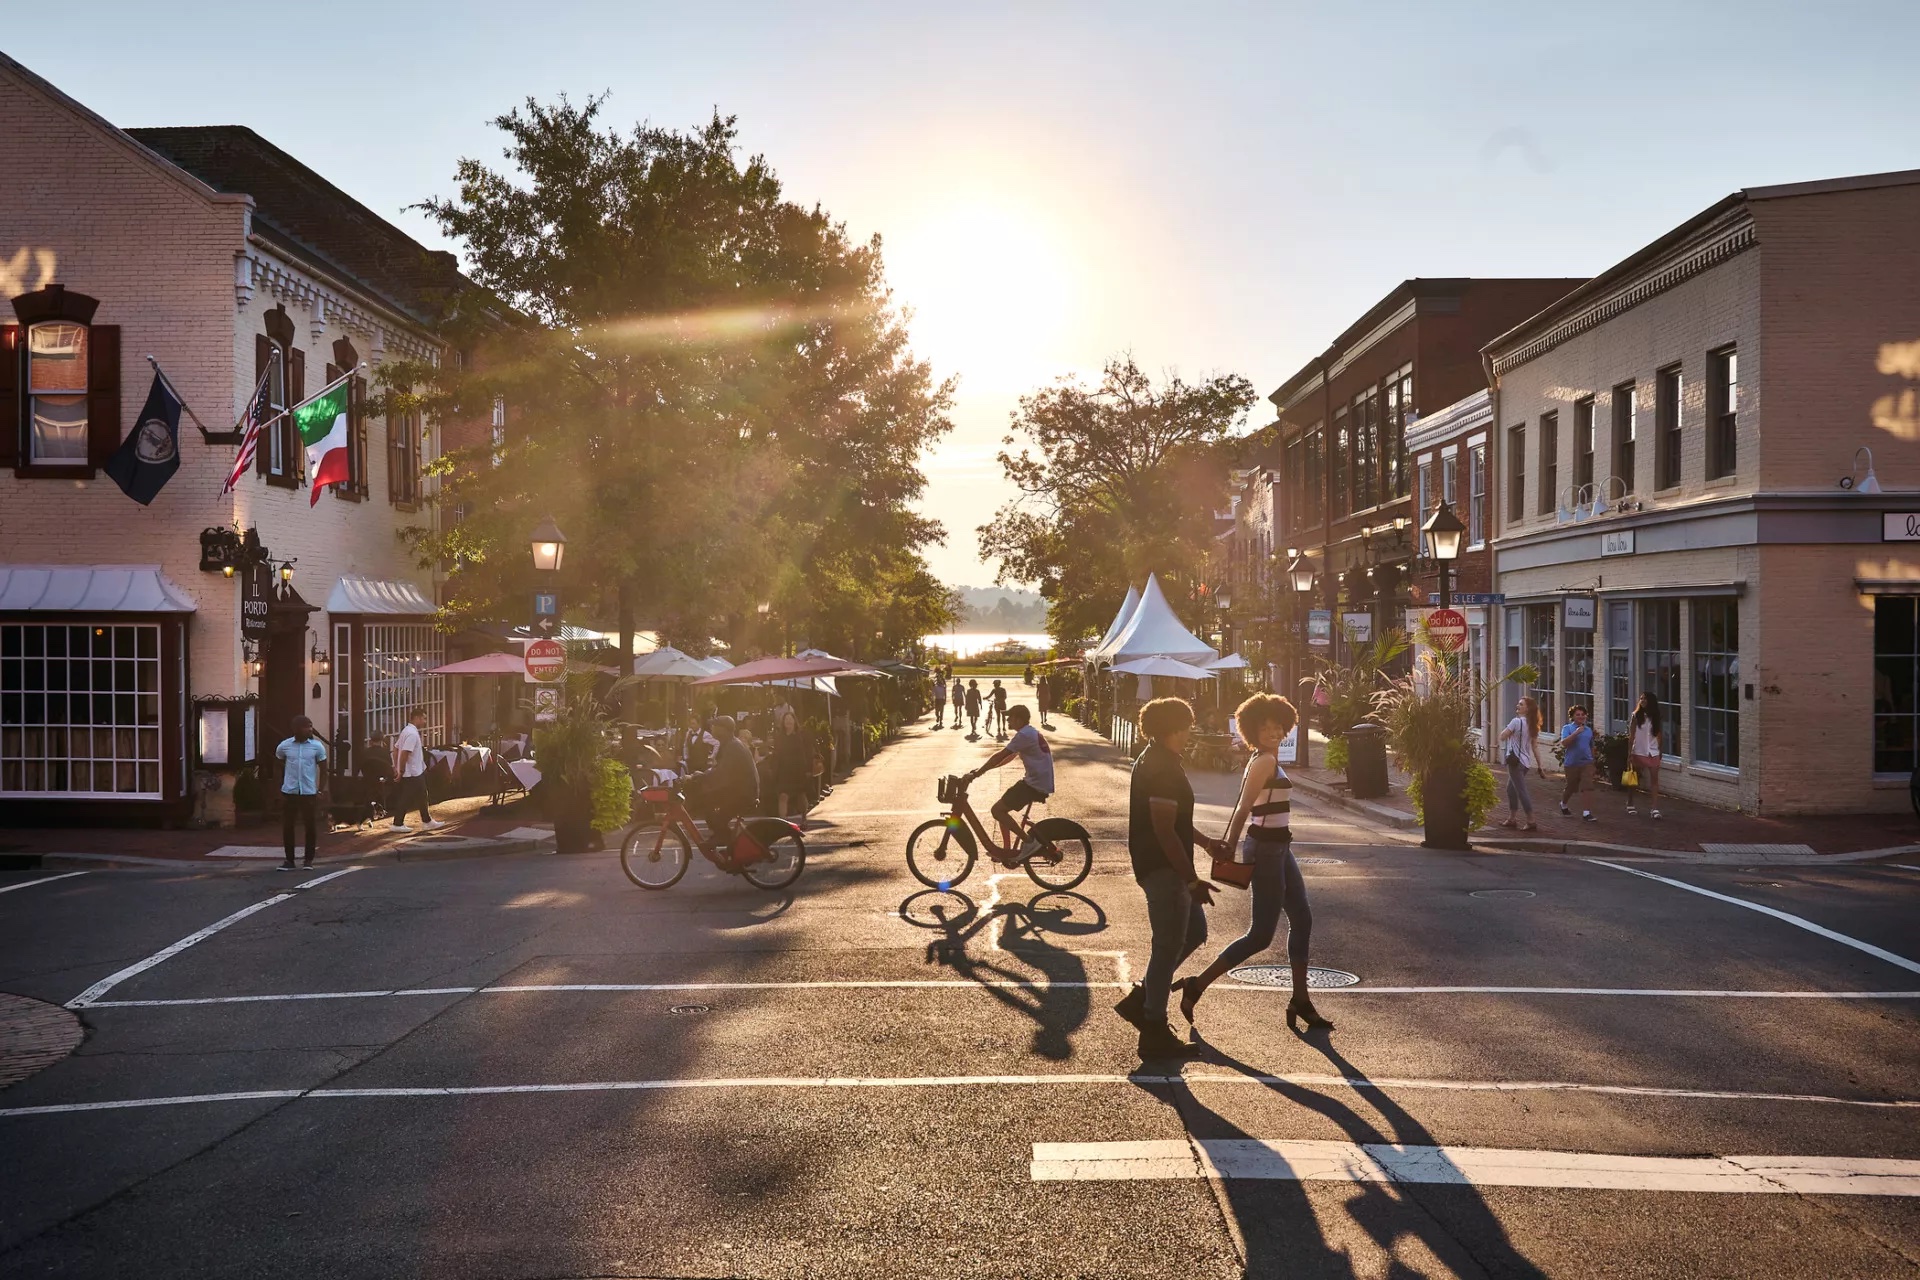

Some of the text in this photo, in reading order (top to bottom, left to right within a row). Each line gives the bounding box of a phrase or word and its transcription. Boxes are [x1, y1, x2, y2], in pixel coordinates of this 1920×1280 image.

[252, 584, 260, 596] IL
[1462, 594, 1476, 603] LEE
[244, 600, 268, 615] PORTO
[540, 596, 552, 612] P
[245, 617, 266, 628] Ristorante
[1445, 617, 1460, 625] NOT
[530, 647, 560, 656] DO NOT
[534, 666, 558, 674] ENTER
